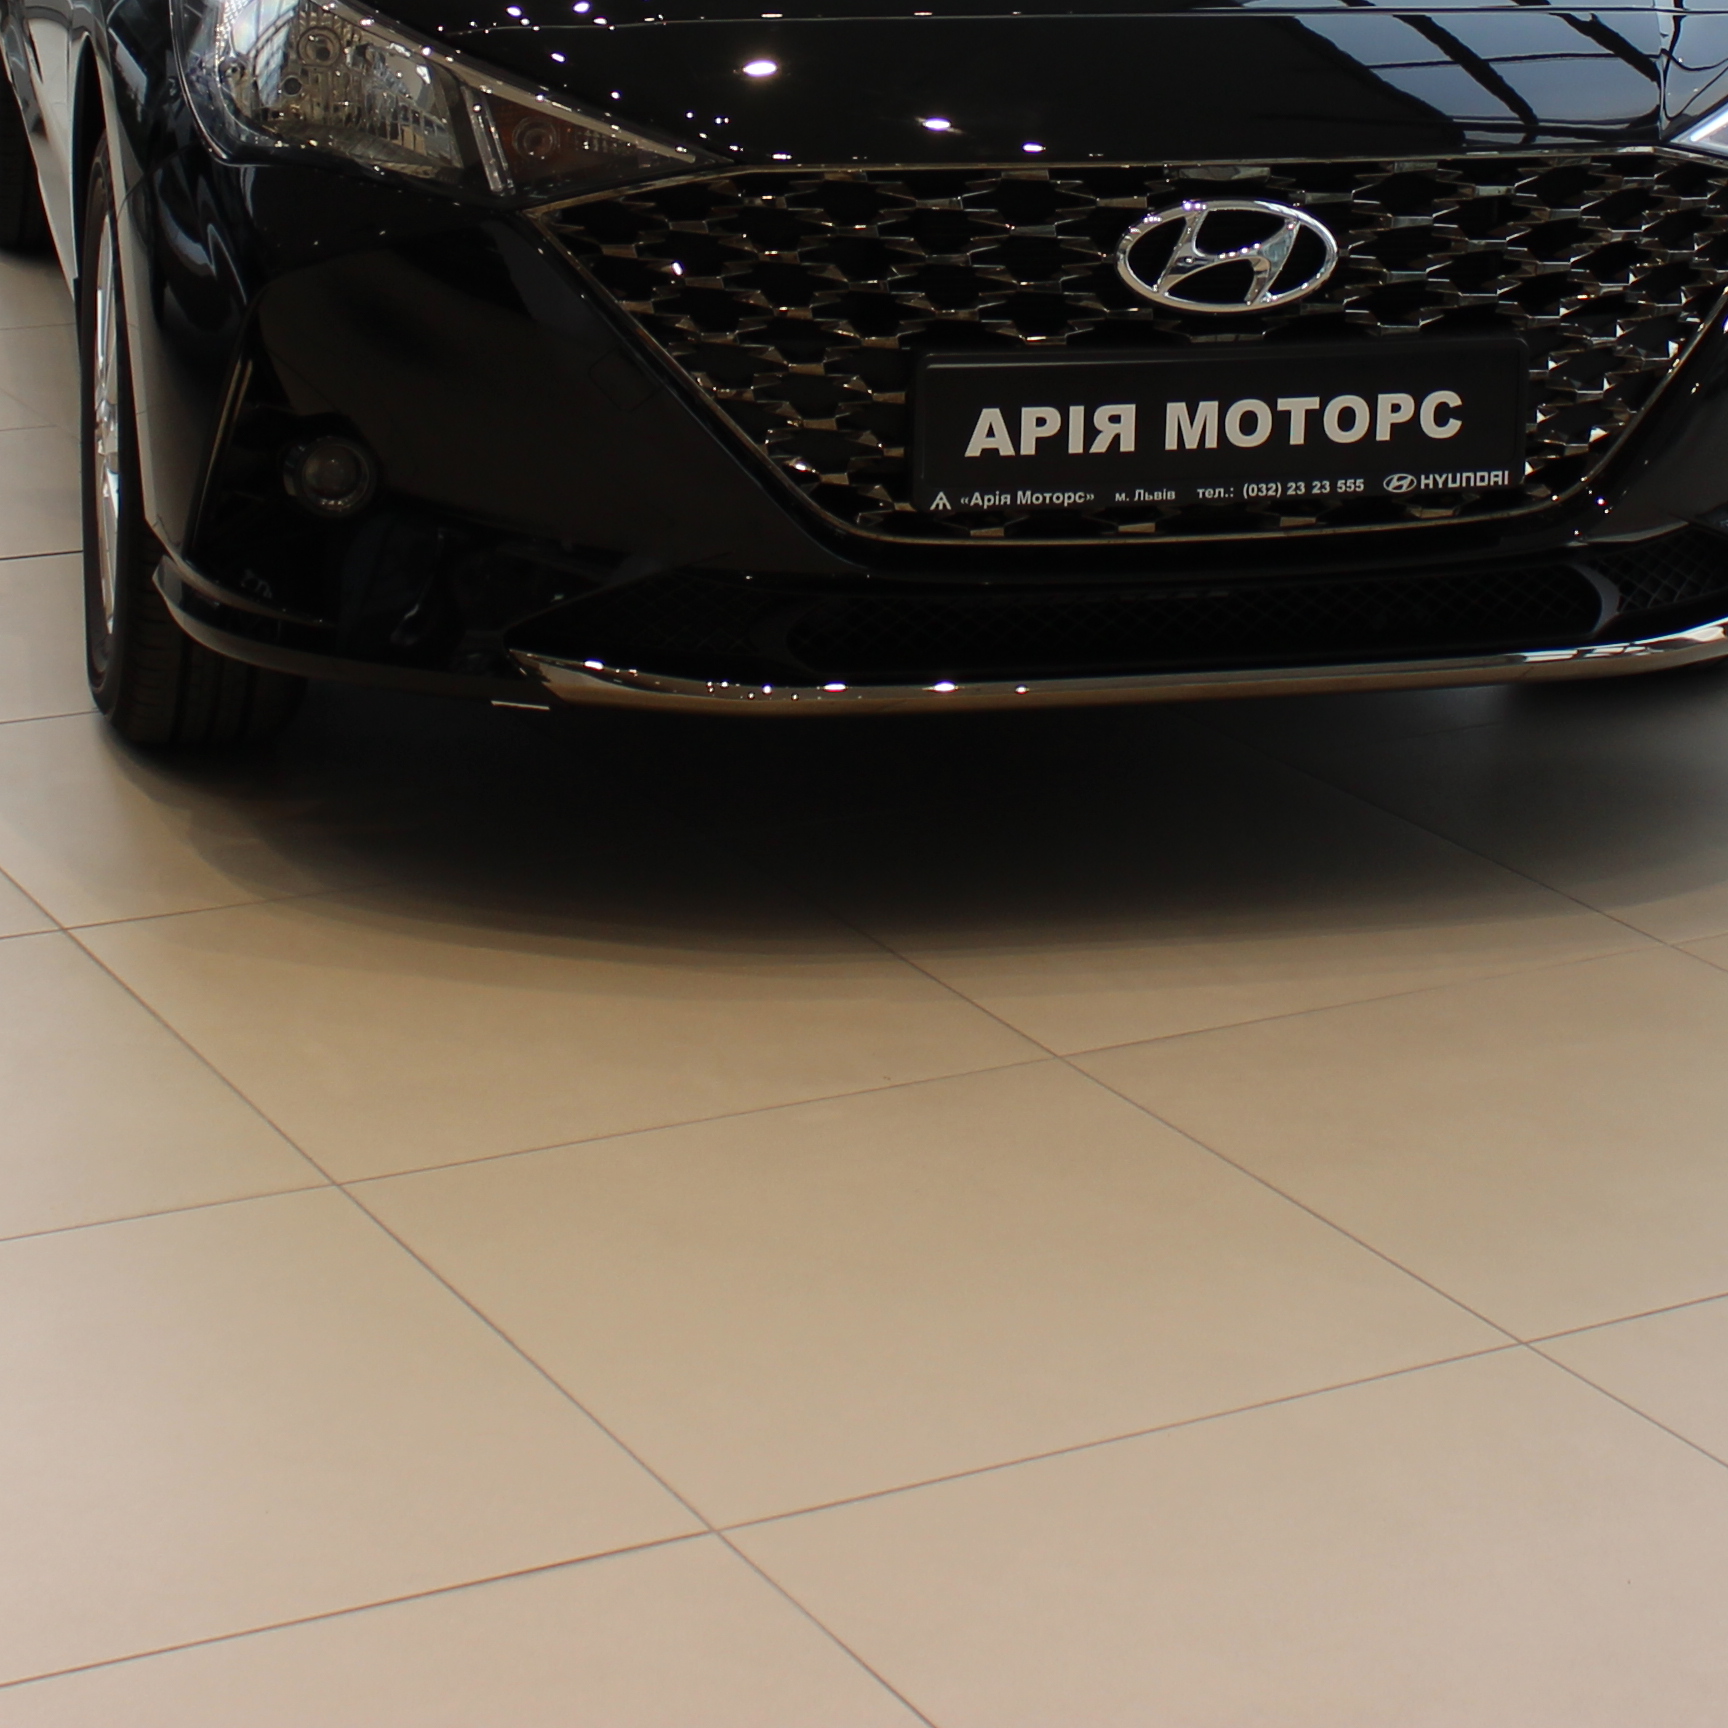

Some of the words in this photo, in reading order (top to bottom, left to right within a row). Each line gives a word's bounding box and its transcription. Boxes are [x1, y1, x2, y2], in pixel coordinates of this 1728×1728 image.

[963, 403, 1137, 458] АРІЯ
[1164, 389, 1464, 452] МОТОРС
[960, 491, 1011, 510] «Арія
[1016, 489, 1095, 507] Моторс»
[1114, 491, 1130, 502] м.
[1133, 488, 1176, 501] Львів
[1196, 486, 1234, 499] тел.:
[1242, 481, 1282, 500] (032)
[1286, 481, 1306, 496] 23
[1311, 480, 1331, 495] 23
[1336, 478, 1365, 493] 555
[1420, 470, 1510, 490] HYUNDAI
